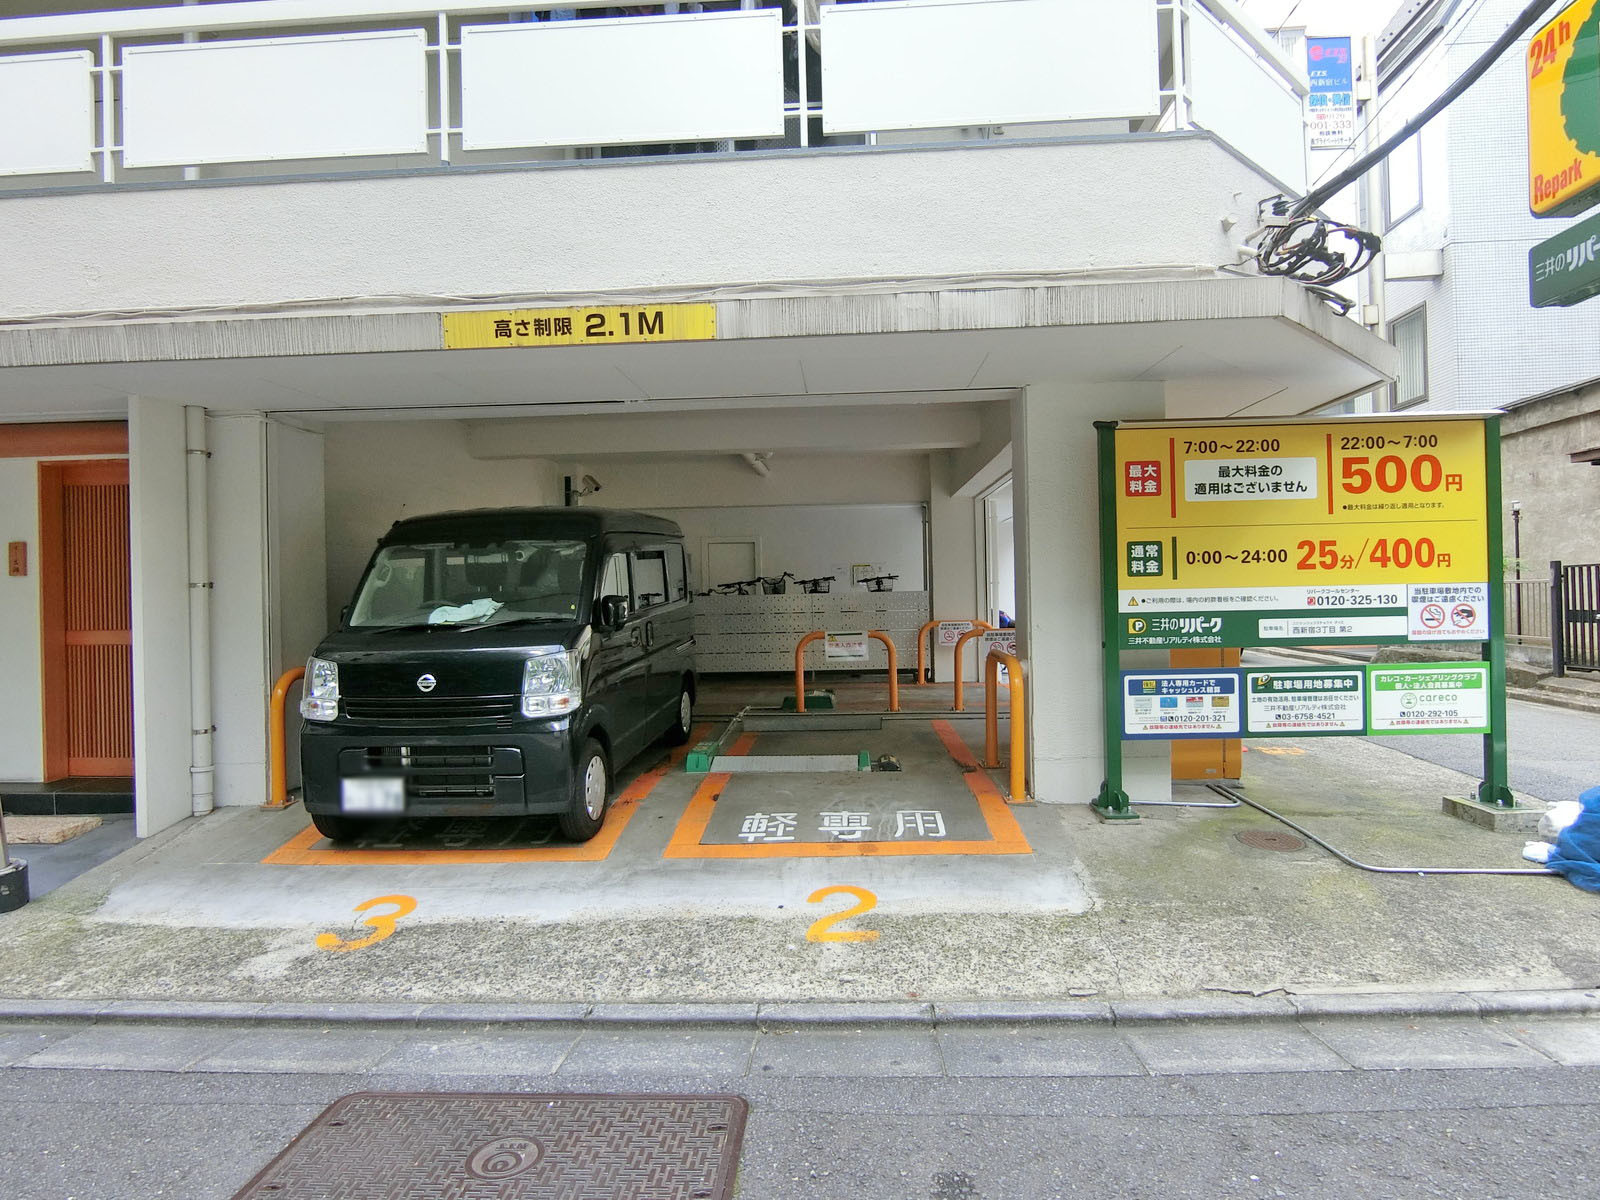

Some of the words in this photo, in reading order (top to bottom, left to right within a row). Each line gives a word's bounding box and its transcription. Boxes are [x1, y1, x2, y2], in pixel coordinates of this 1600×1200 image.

[1530, 20, 1570, 79] 24h
[1534, 157, 1582, 205] Repark
[493, 317, 573, 338] 高さ制限
[585, 311, 664, 337] 2.1M
[1129, 464, 1157, 478] 最大
[1218, 465, 1283, 478] 最大料金の
[1129, 480, 1158, 493] 料金
[1194, 480, 1308, 495] 適用はございません
[1131, 544, 1159, 558] 通常
[1131, 560, 1159, 573] 料金
[1317, 594, 1398, 606] 0120-325-130
[1151, 616, 1222, 634] 三井のリパーク
[1128, 636, 1222, 645] 三井不動産リアルティ株式会社
[1161, 679, 1216, 687] 法人専用カードで
[1273, 679, 1353, 689] 駐車場用地募集中
[1419, 693, 1458, 702] careco
[1174, 714, 1226, 722] 0120-201-321
[1281, 712, 1336, 720] 03-6758-4521
[806, 886, 880, 943] 2
[316, 895, 418, 952] 3
